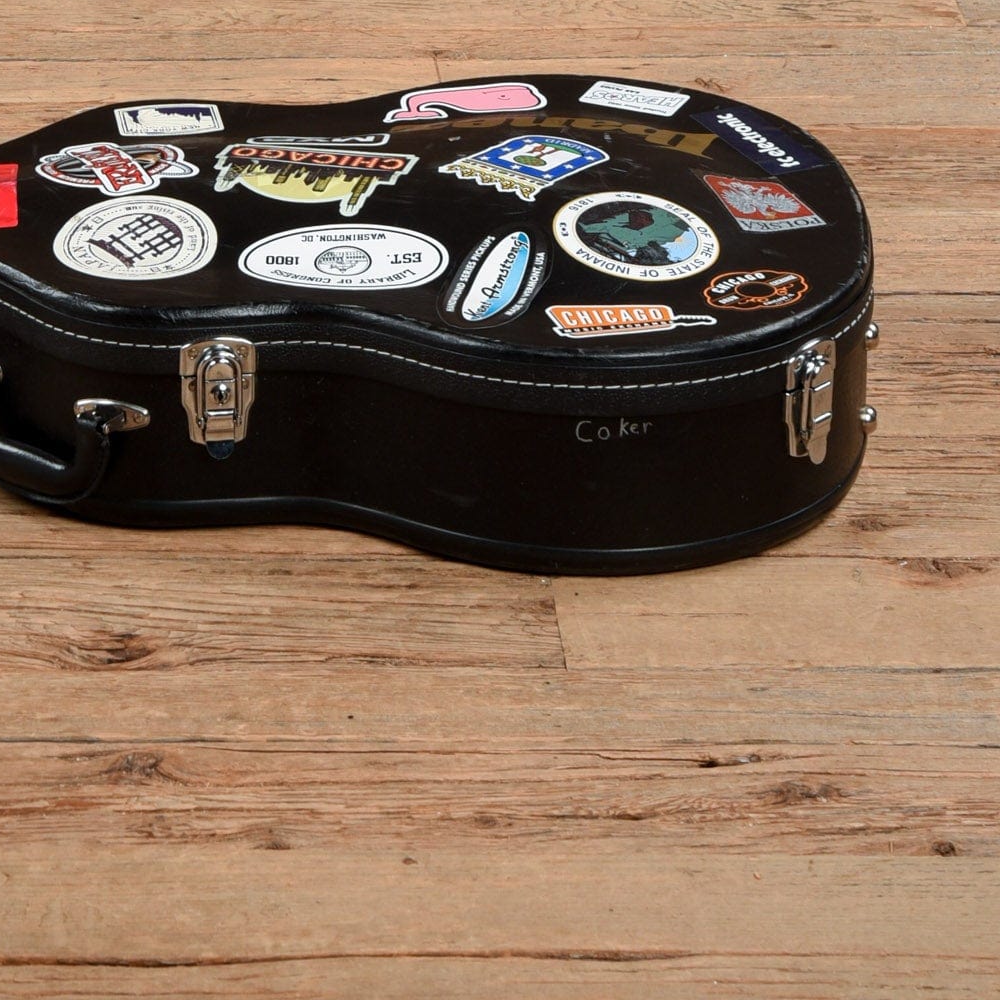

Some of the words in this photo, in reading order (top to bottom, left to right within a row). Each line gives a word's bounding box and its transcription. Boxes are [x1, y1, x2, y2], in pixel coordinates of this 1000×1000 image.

[544, 138, 594, 154] MADRID
[231, 146, 406, 170] CHICAGO
[568, 198, 594, 211] 1816
[664, 203, 696, 222] SEAL
[697, 226, 711, 238] OF
[740, 217, 822, 230] POLSKA
[315, 232, 387, 242] WASHINGTON,
[701, 241, 714, 258] THE
[73, 245, 120, 272] JAPAN
[265, 255, 301, 266] 1800
[386, 252, 422, 265] EST.
[460, 261, 477, 282] SERIES
[470, 235, 496, 262] PICKUPS
[534, 252, 546, 265] USA
[576, 248, 630, 274] INDIANA
[665, 259, 705, 276] STATE
[269, 269, 332, 284] CONGRESS
[358, 268, 417, 285] LIBRARY
[463, 302, 492, 318] Kent
[481, 240, 529, 299] Armstrong
[711, 272, 766, 294] CHICAGO
[560, 308, 664, 326] CHICAGO
[575, 417, 653, 442] Coker
